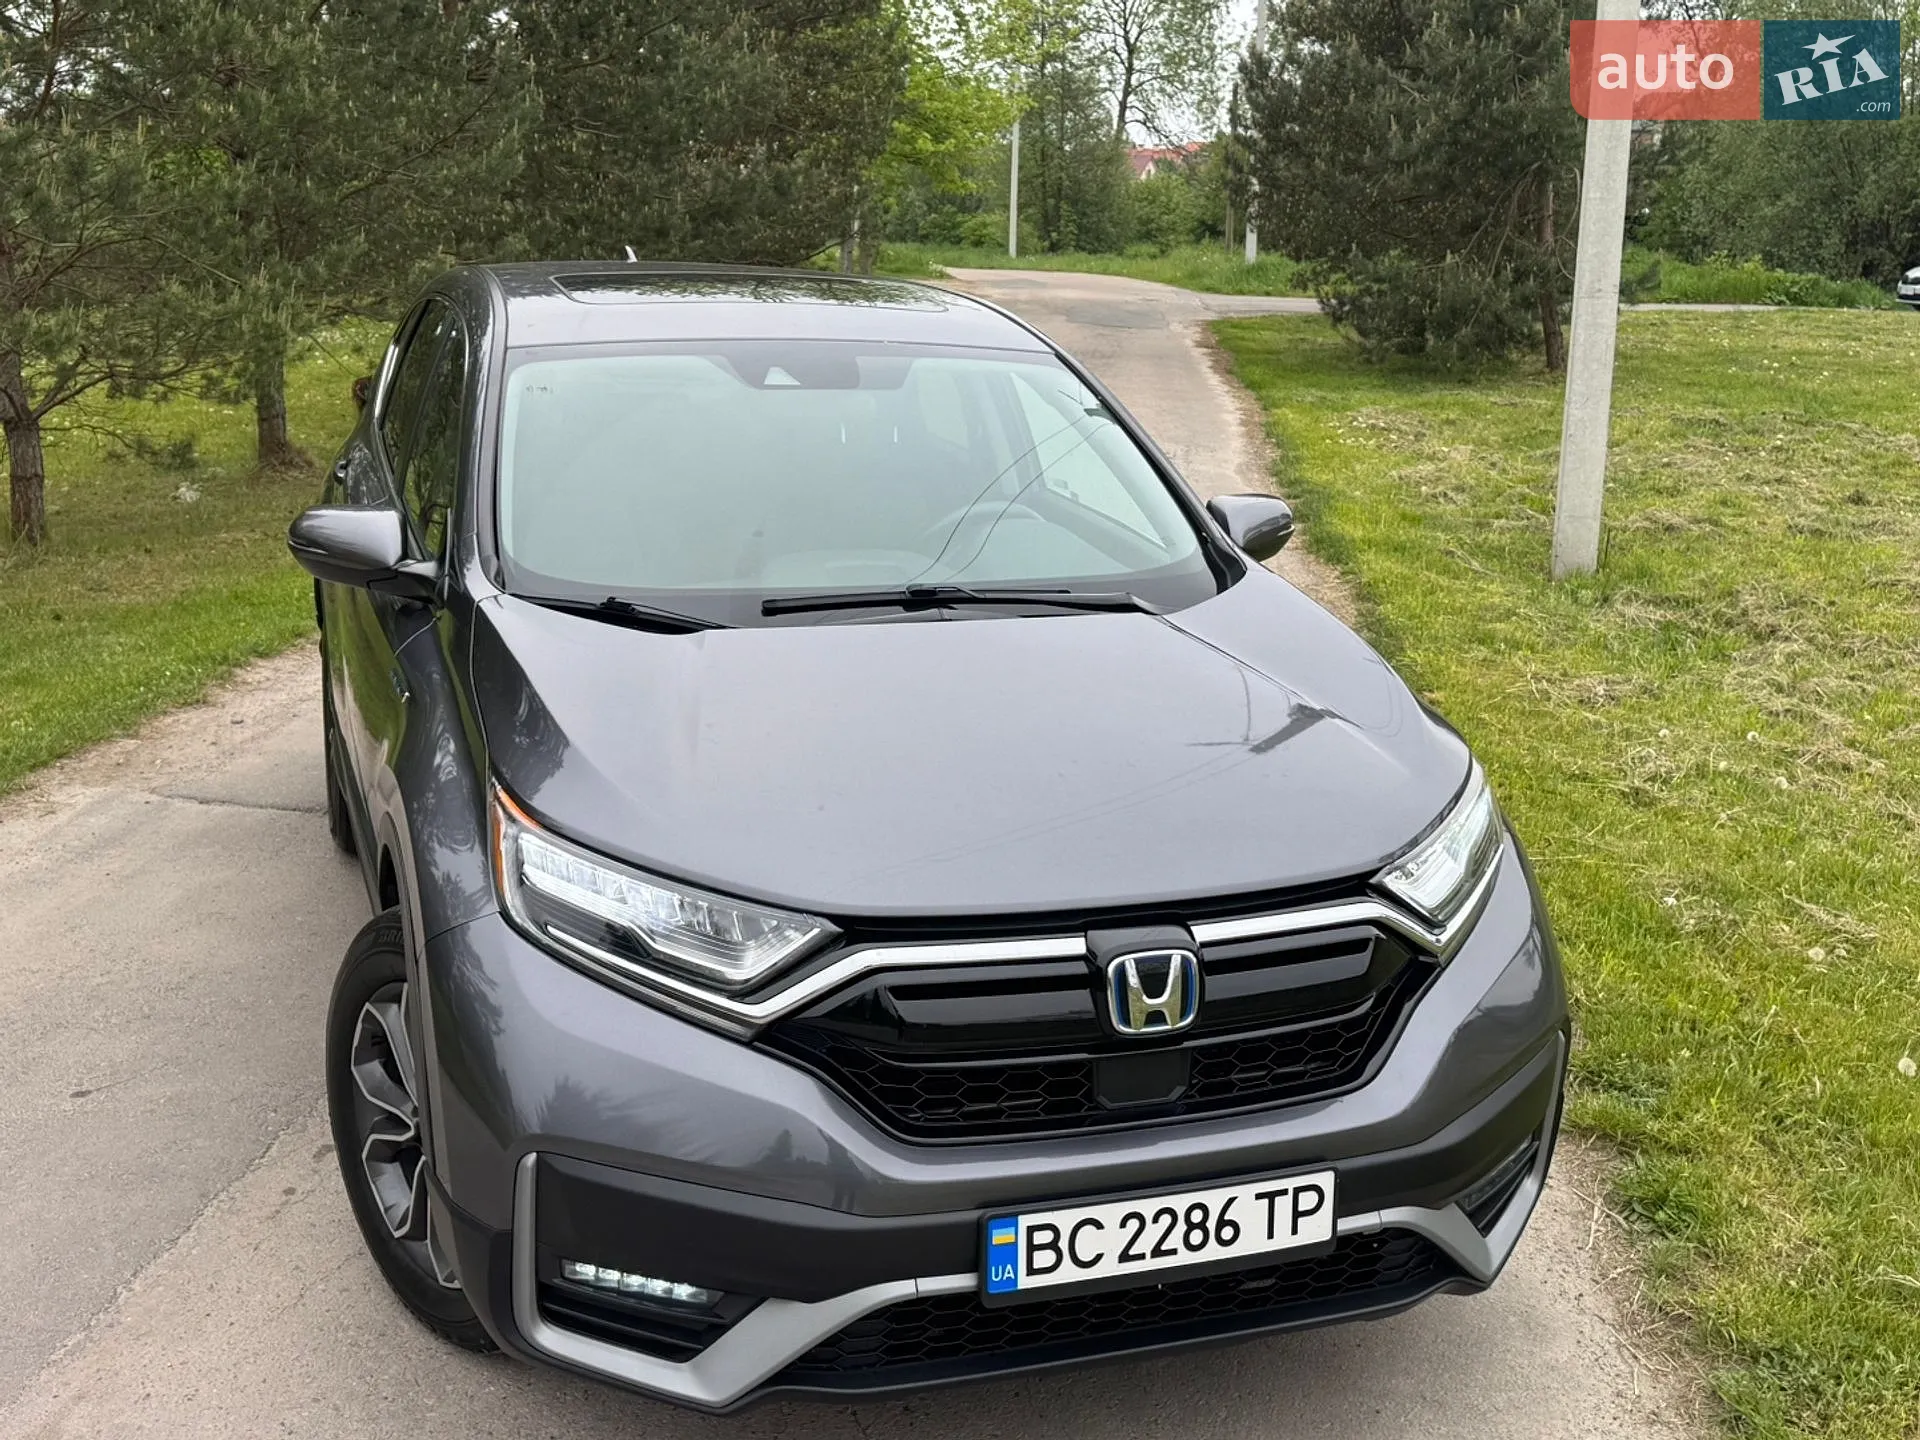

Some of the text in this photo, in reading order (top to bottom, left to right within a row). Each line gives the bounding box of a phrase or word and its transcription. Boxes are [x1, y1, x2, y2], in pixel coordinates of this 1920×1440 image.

[1025, 1183, 1326, 1277] BC 2286 TP
[991, 1264, 1015, 1281] UA
